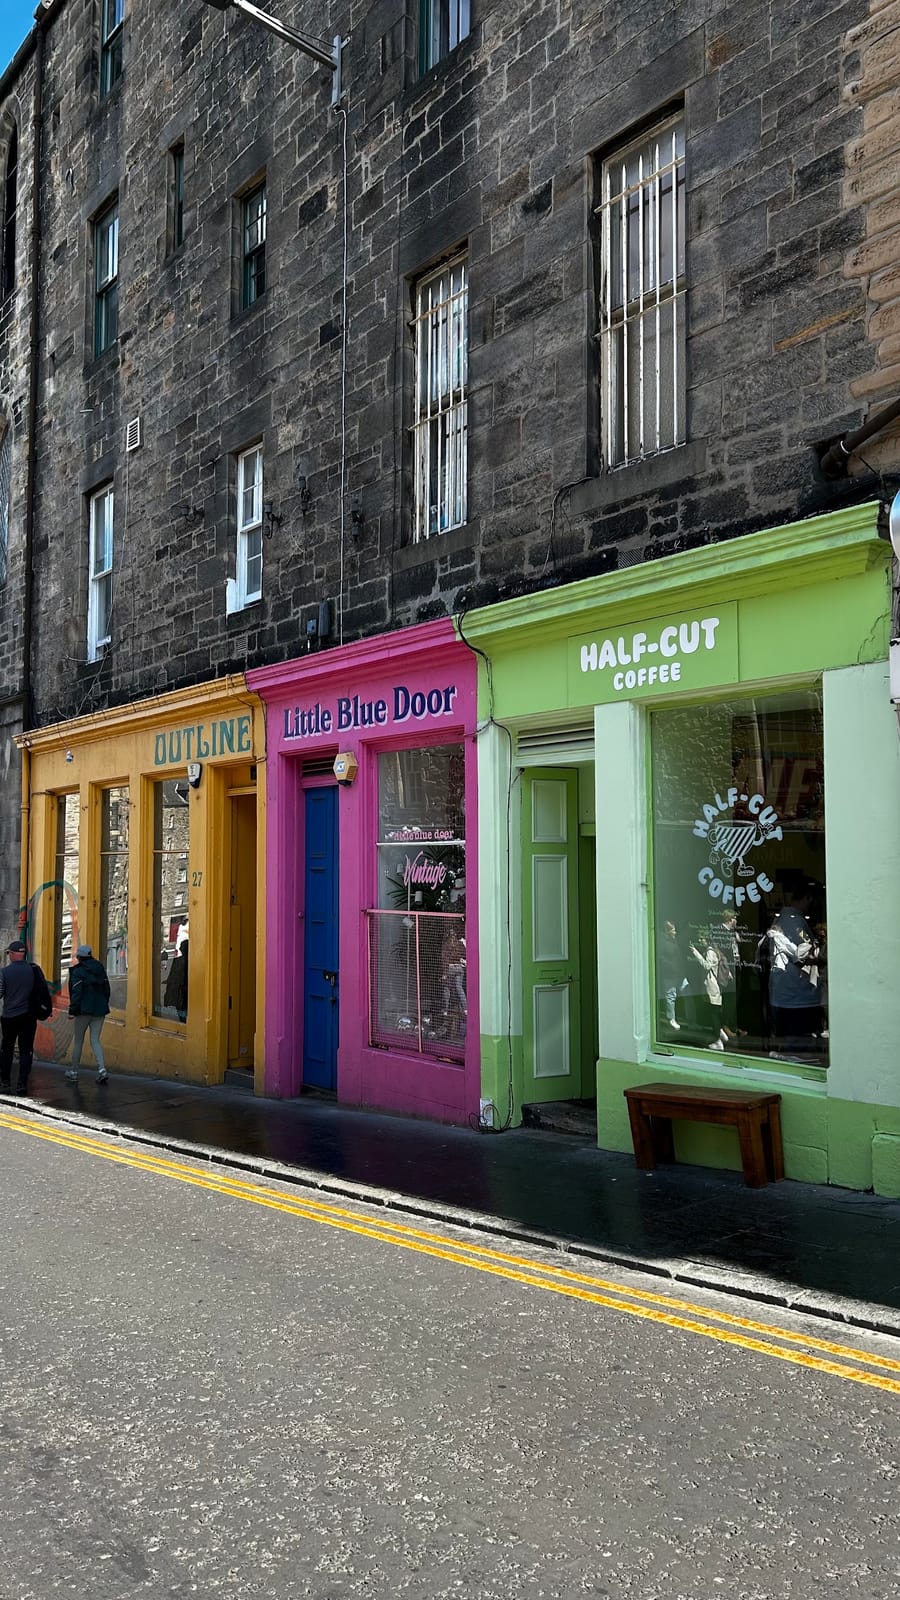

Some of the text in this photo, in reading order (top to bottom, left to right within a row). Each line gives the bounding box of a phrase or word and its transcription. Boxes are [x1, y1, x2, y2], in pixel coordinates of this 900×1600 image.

[580, 617, 720, 673] HALF-CUT
[613, 662, 681, 691] COFFEE
[283, 685, 457, 742] Little Blue Door
[154, 715, 251, 766] OUTLINE
[692, 787, 784, 841] HALF-CUT
[192, 871, 203, 887] 27
[698, 866, 774, 907] COFFEE
